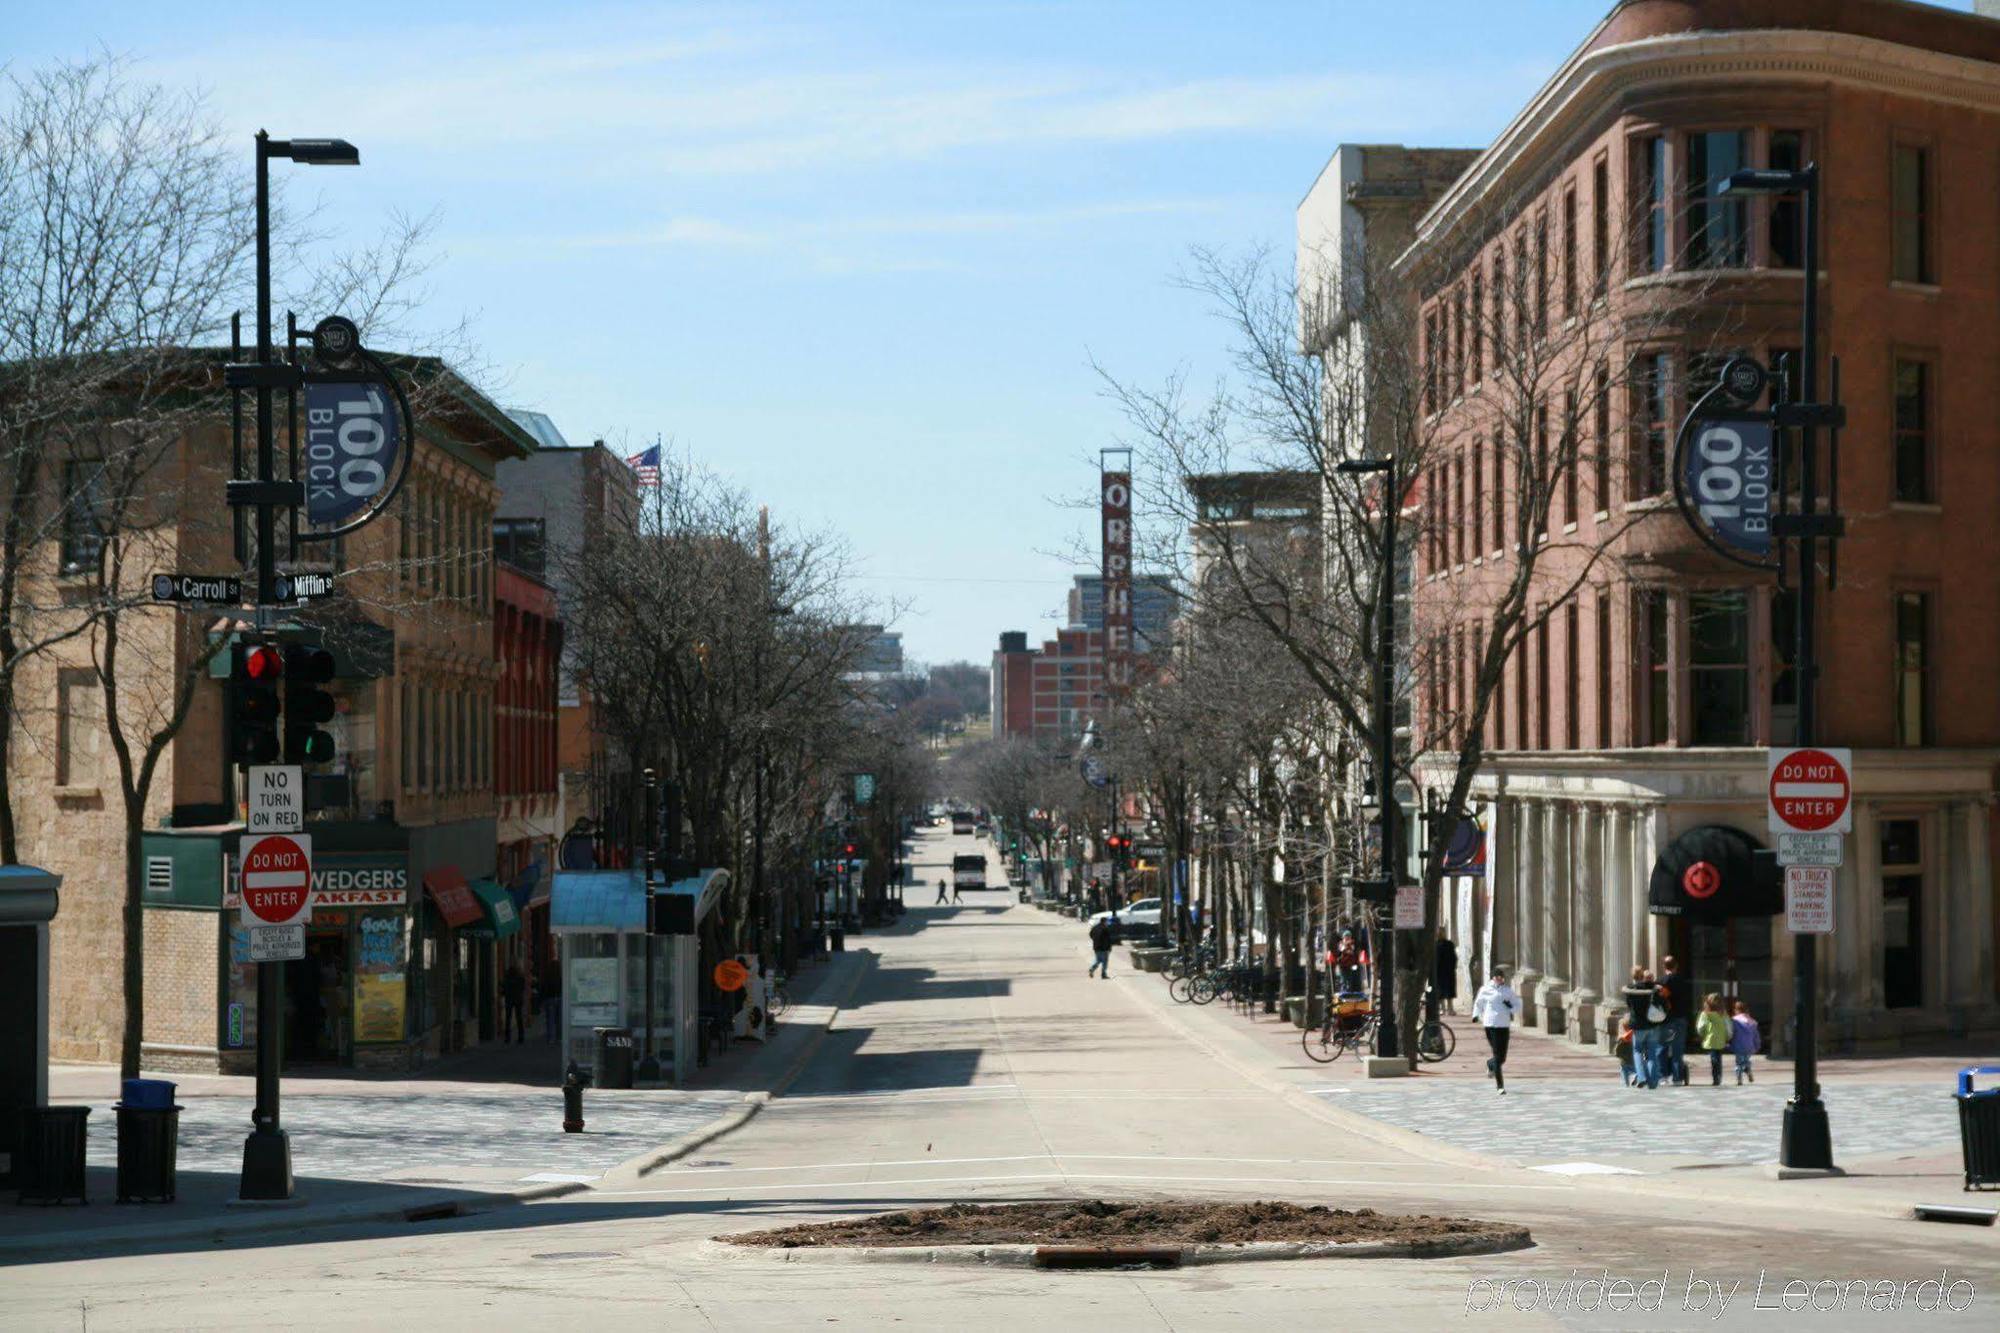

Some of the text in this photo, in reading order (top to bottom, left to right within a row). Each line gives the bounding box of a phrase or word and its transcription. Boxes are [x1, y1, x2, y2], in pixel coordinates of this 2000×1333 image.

[338, 390, 386, 497] 100
[309, 408, 336, 499] BLOCK
[1699, 427, 1743, 527] 100
[1744, 446, 1769, 532] BLOCK
[182, 577, 226, 599] Carroll
[294, 575, 325, 597] Mifflin
[1105, 483, 1129, 686] ORPHEU
[264, 772, 288, 788] NO
[1783, 765, 1836, 778] DO NOT
[260, 793, 291, 807] TURN
[1784, 802, 1835, 815] ENTER
[253, 811, 299, 826] ON RED
[252, 853, 299, 869] DO NOT
[255, 892, 298, 907] ENTER
